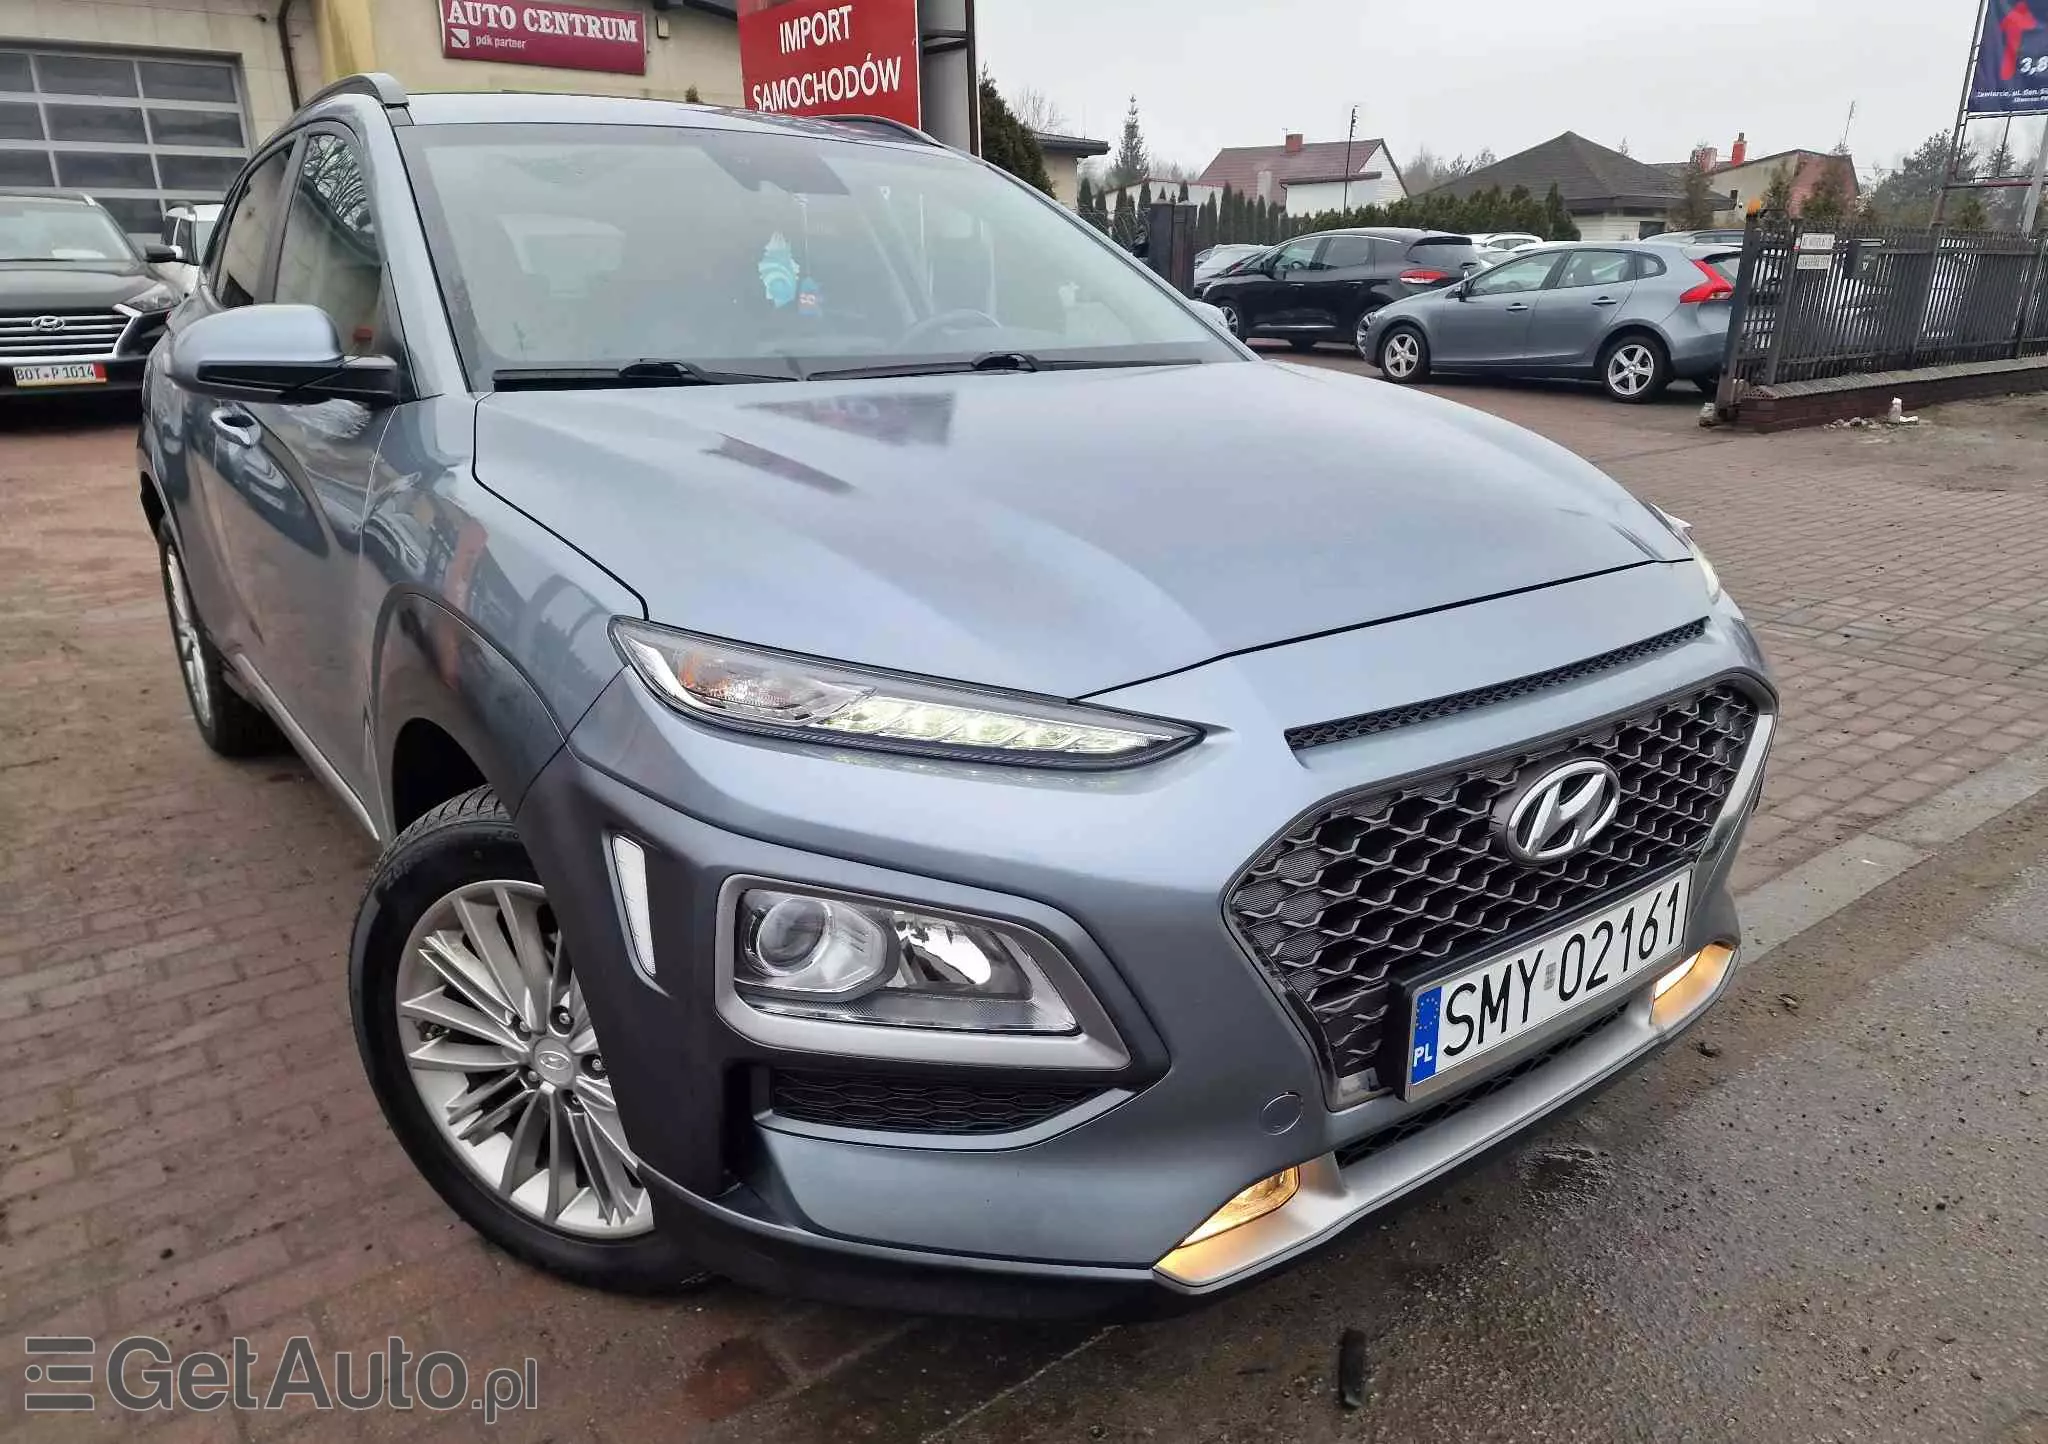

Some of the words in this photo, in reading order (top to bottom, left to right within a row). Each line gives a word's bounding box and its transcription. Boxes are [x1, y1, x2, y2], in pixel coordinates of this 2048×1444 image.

[448, 1, 517, 30] AUTO
[523, 8, 638, 42] CENTRUM
[475, 36, 494, 48] pdk
[494, 37, 526, 49] partner
[778, 5, 853, 54] IMPORT
[752, 53, 901, 112] SAMOCHODÓW
[1443, 949, 1544, 1056] SMY
[1557, 882, 1680, 1001] 02161
[1413, 1046, 1433, 1067] PL
